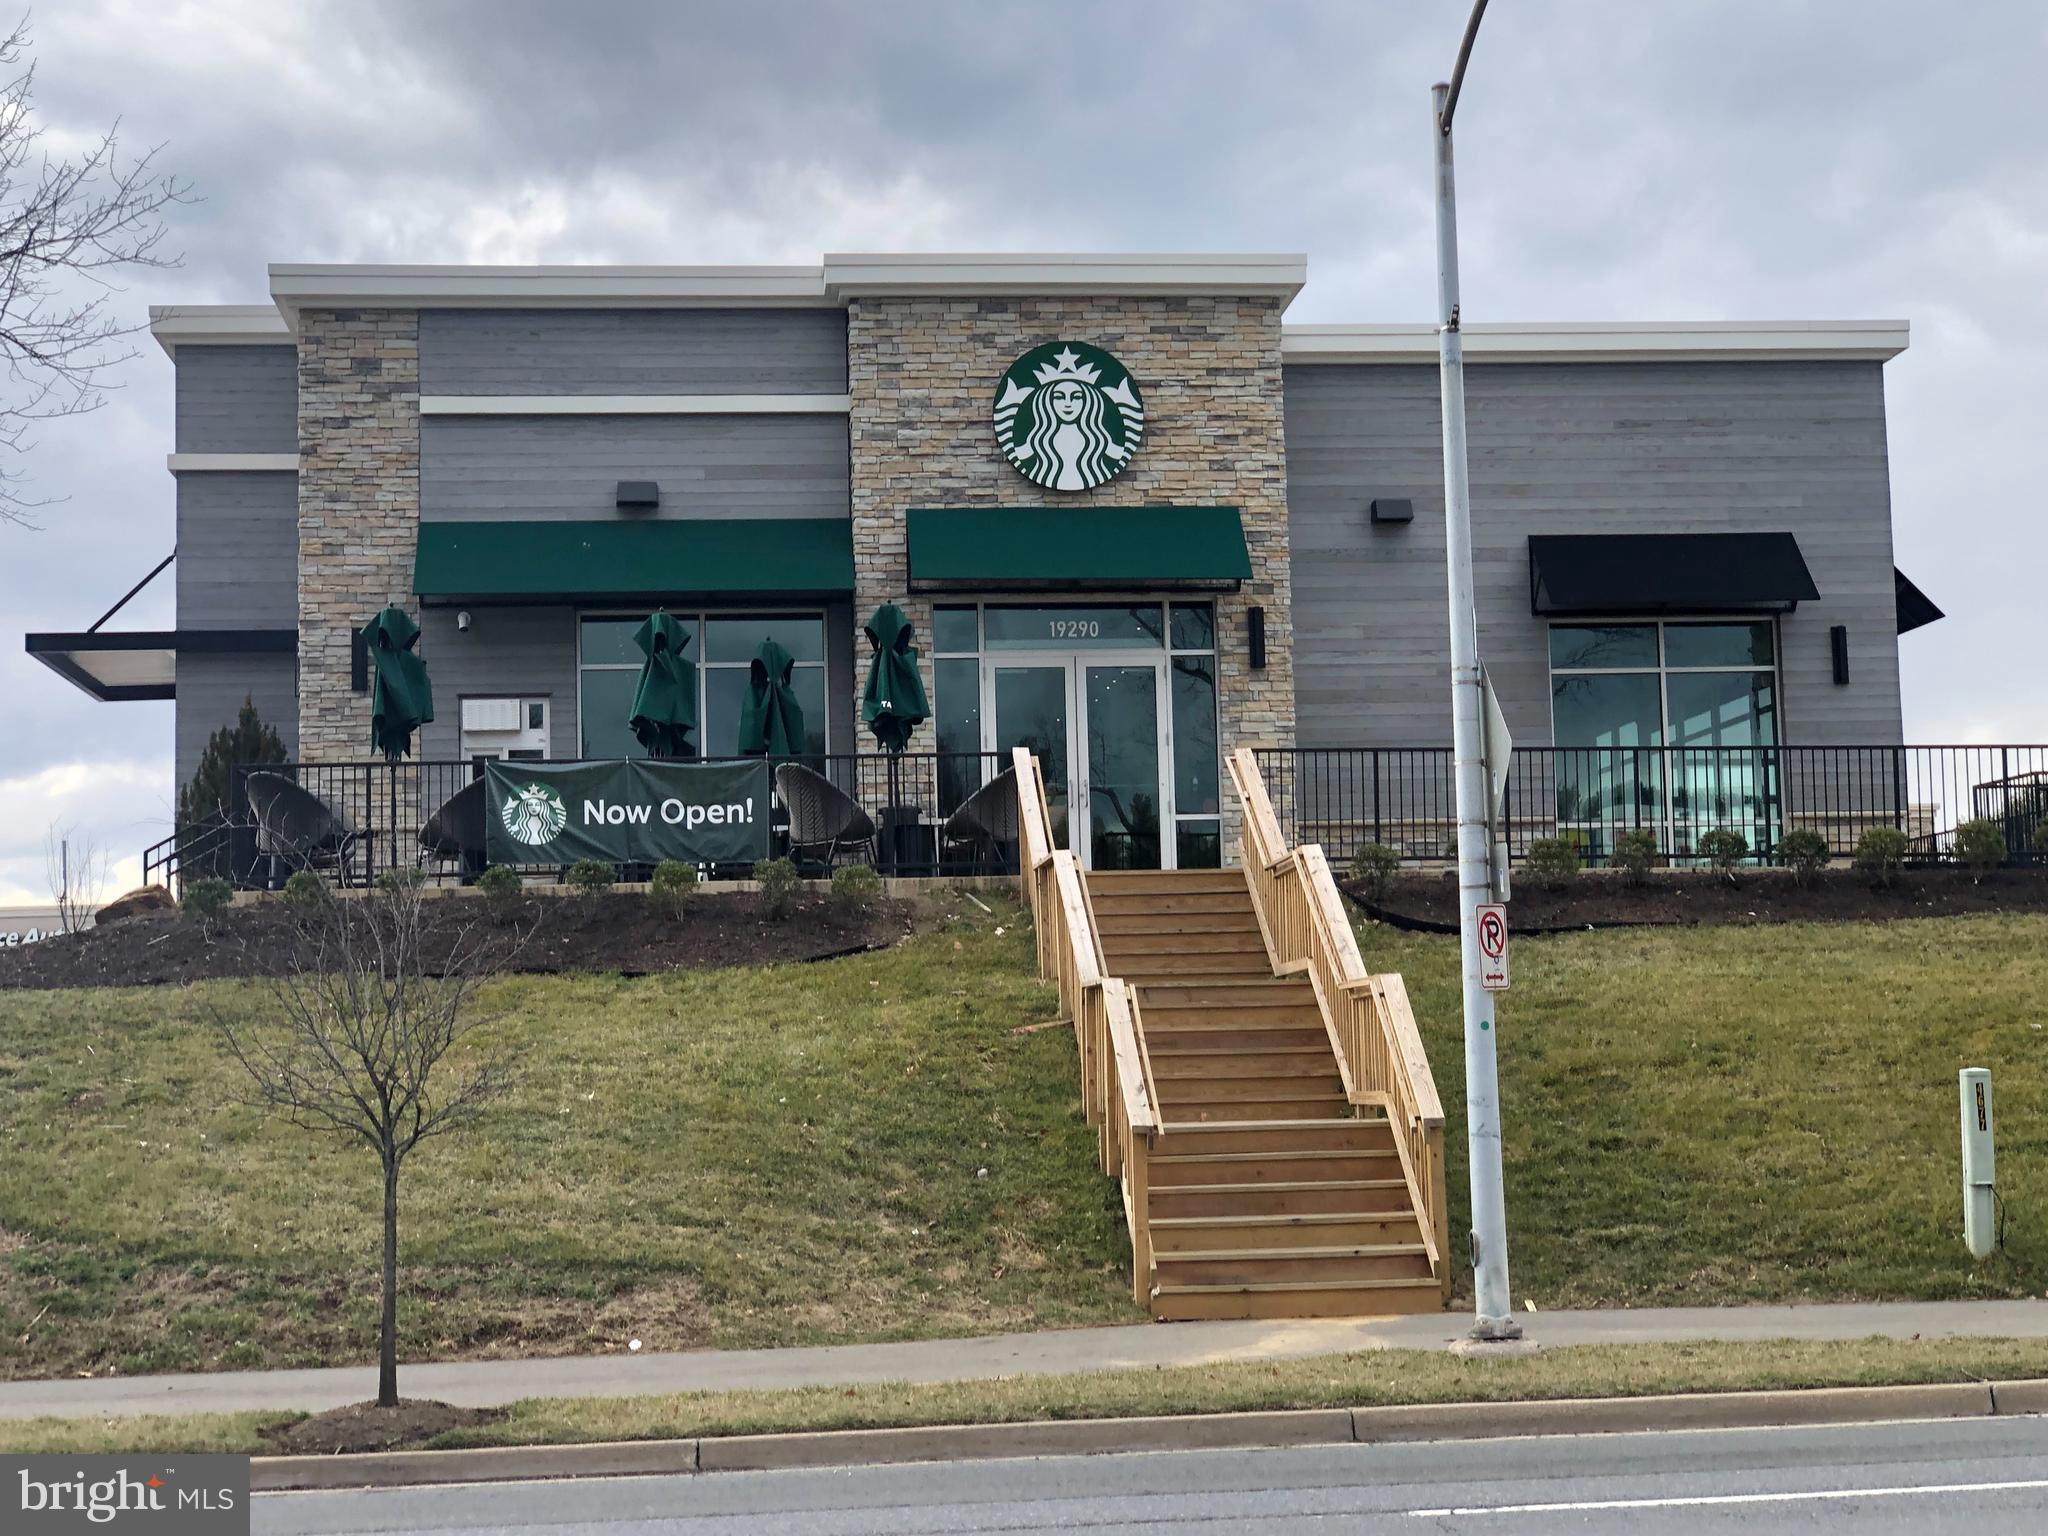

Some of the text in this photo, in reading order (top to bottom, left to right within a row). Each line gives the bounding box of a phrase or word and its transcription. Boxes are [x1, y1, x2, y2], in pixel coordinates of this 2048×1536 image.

[1049, 621, 1099, 638] 19290
[583, 797, 754, 830] Now Open!
